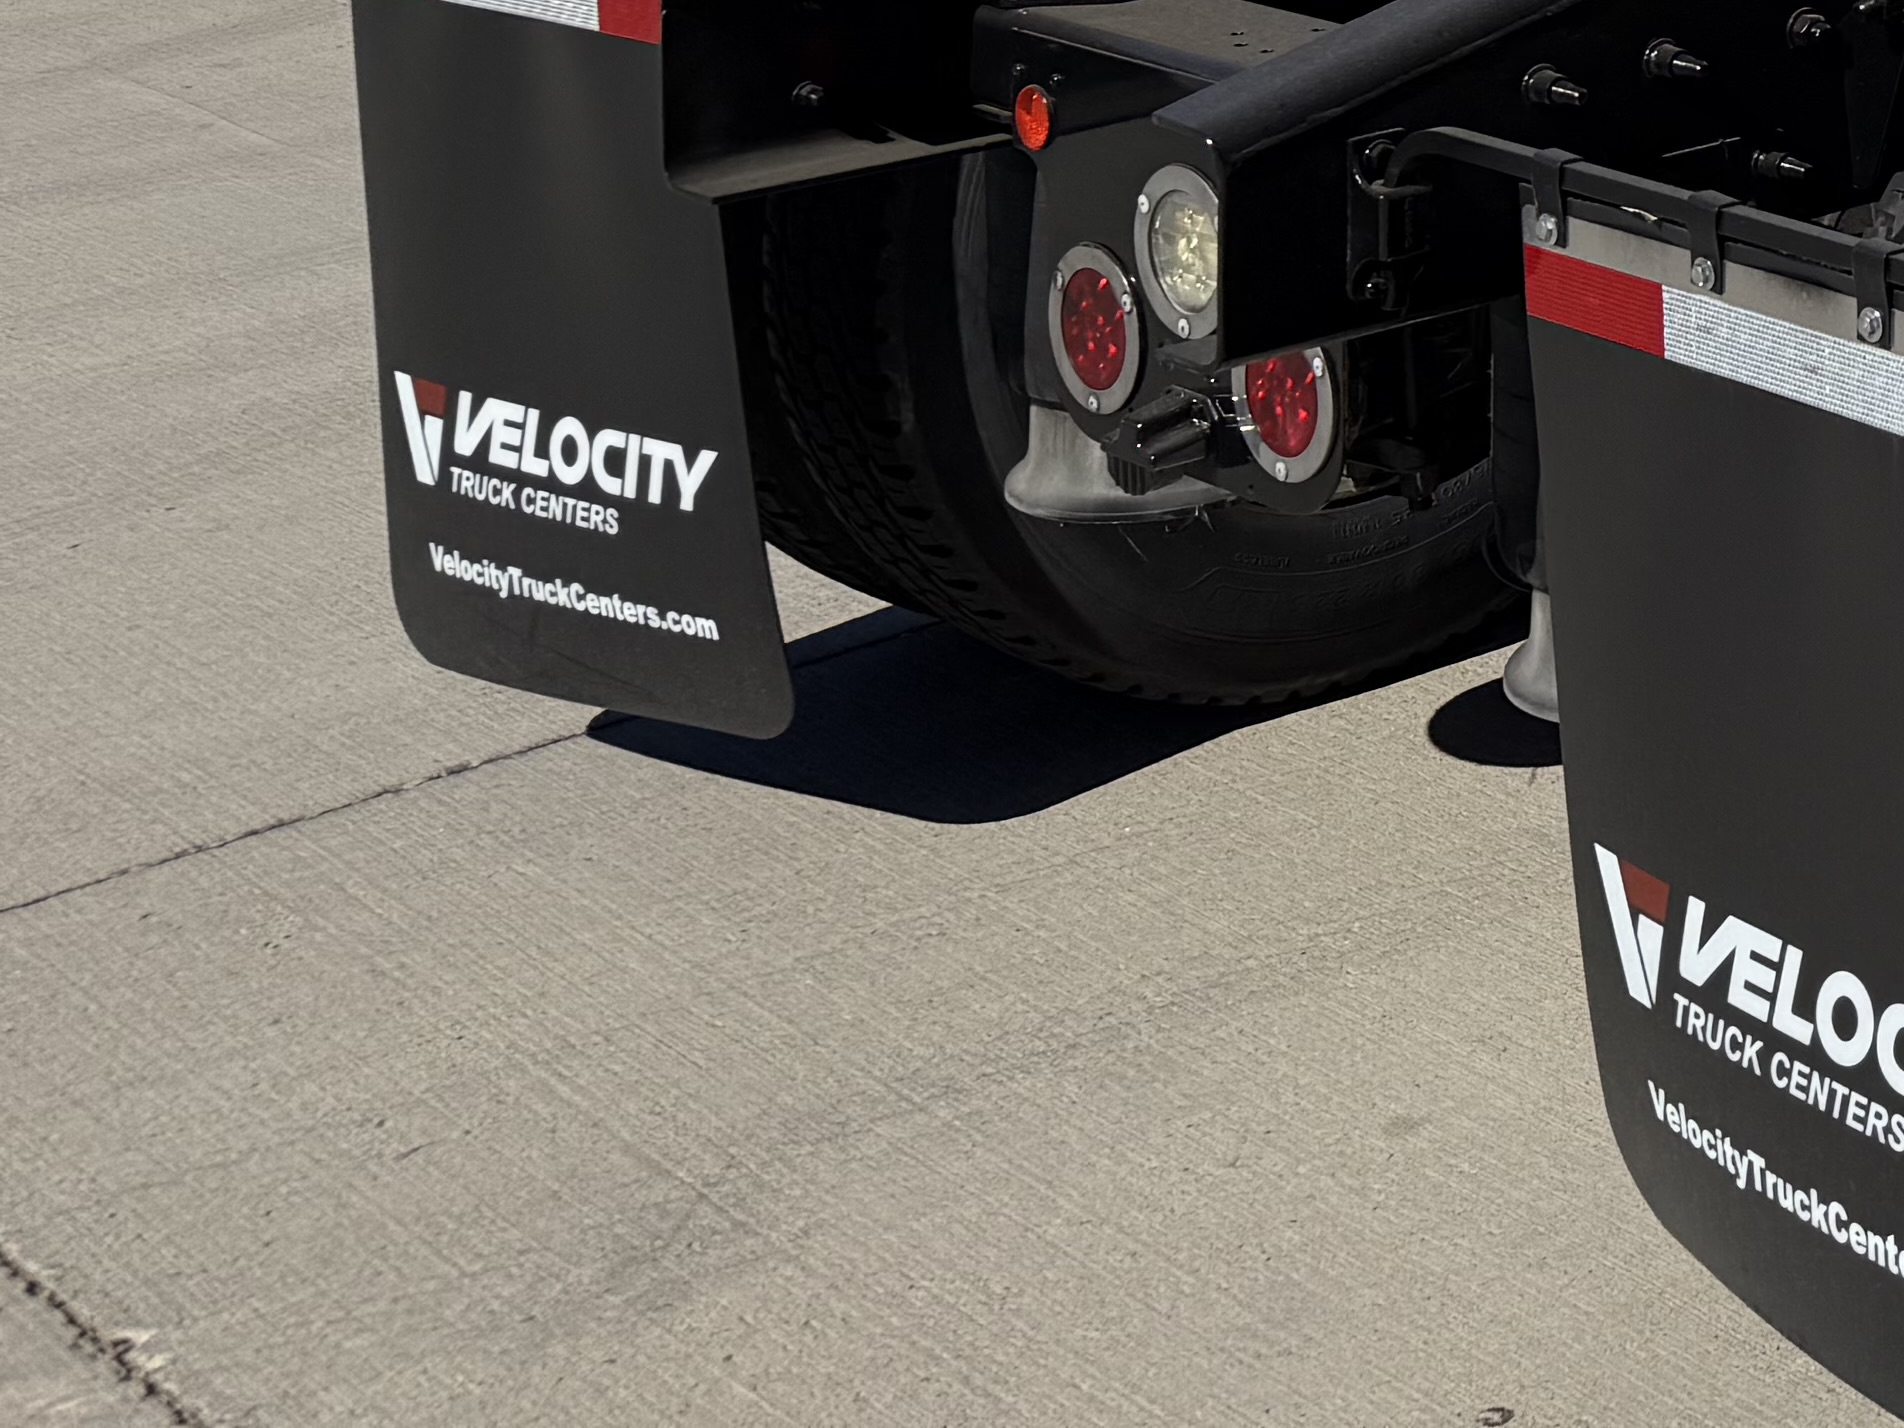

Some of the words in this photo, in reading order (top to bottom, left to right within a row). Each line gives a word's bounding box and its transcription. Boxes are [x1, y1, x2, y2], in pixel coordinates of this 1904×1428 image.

[453, 390, 719, 511] VELOCITY
[450, 466, 515, 509] TRUCK
[520, 488, 619, 535] CENTERS
[429, 542, 719, 641] VelocityTruckCenters.com
[1673, 992, 1764, 1077] TRUCK
